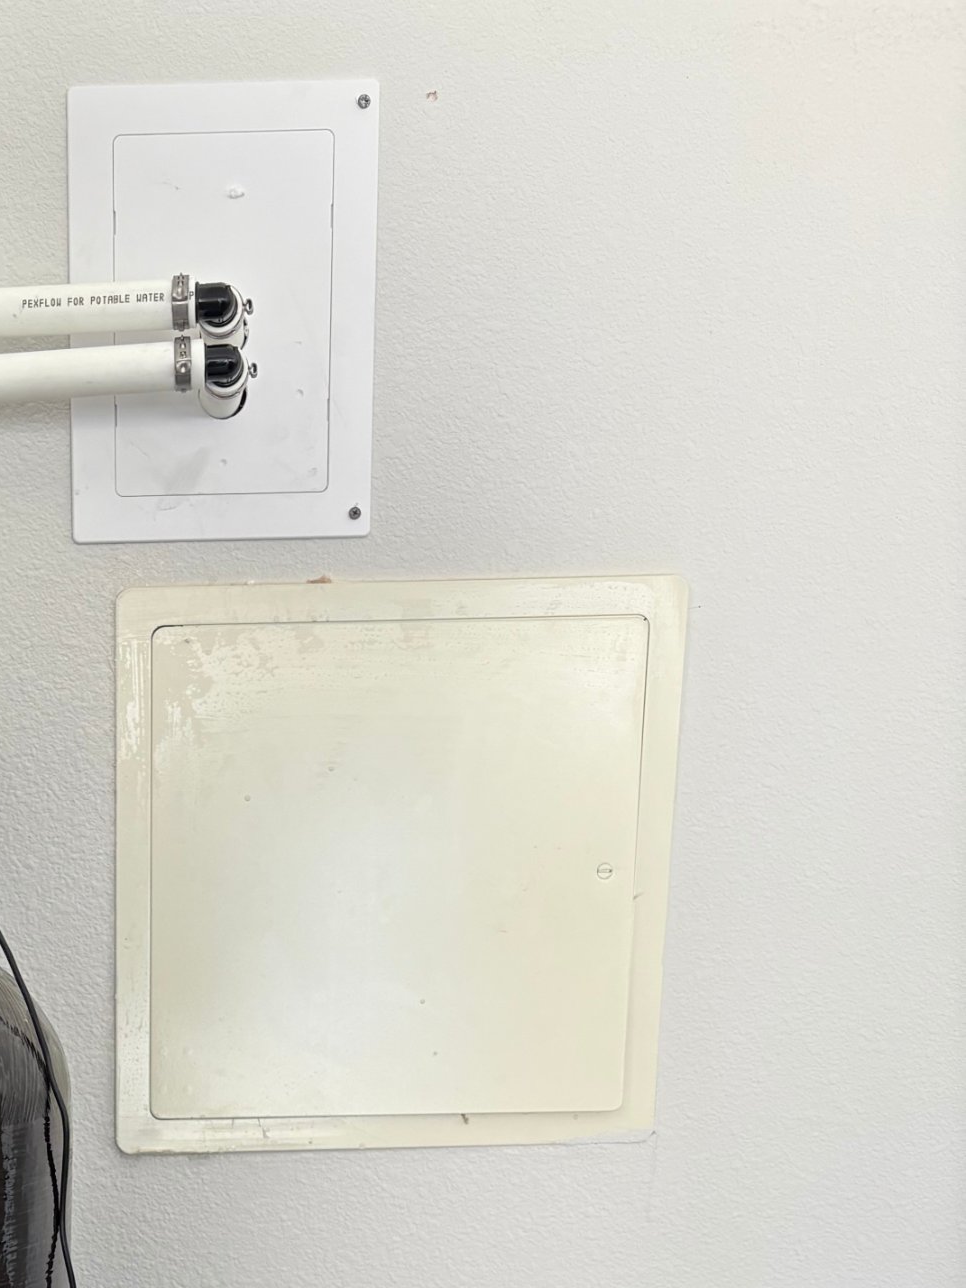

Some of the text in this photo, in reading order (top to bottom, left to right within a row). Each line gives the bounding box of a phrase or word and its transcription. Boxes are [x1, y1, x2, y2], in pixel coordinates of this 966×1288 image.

[22, 297, 61, 308] PEXFLOW
[67, 297, 84, 306] FOR
[90, 294, 130, 305] POTABLE
[136, 293, 165, 303] WATER
